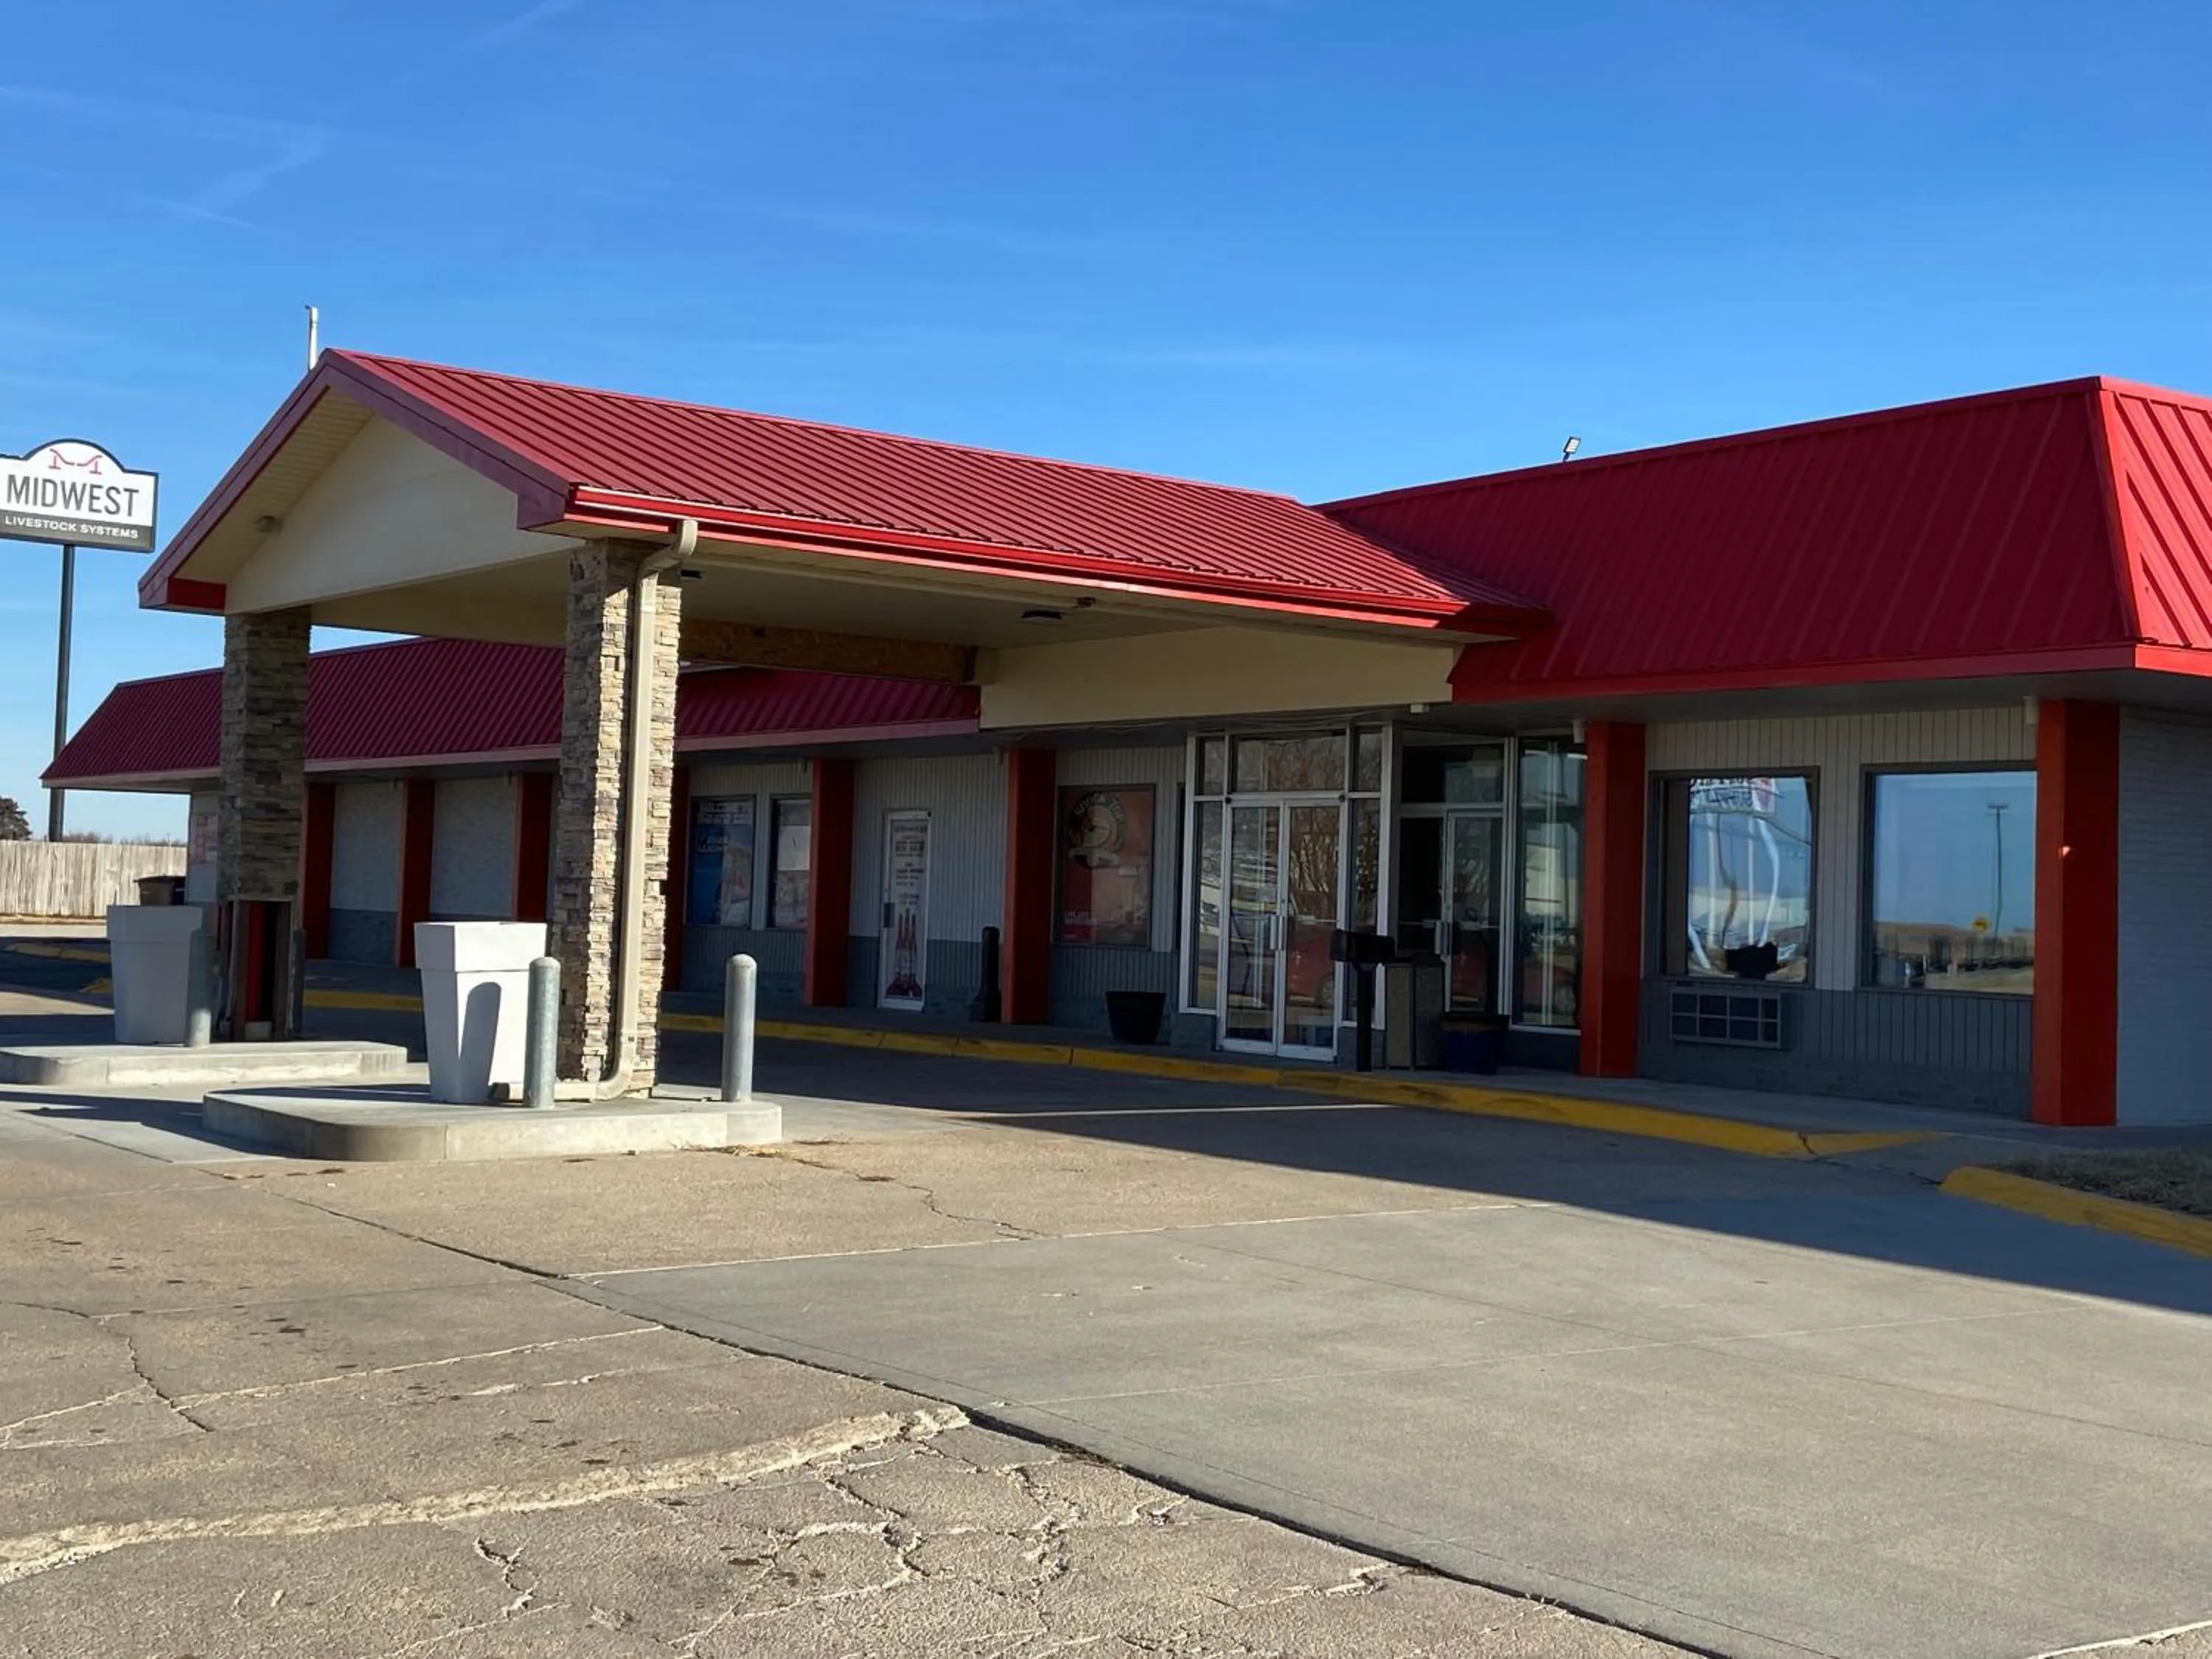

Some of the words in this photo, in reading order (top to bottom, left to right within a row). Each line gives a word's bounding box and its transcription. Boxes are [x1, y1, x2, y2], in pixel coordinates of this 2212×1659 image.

[7, 474, 139, 517] MIDWEST
[5, 515, 77, 532] LIVESTOCK
[80, 524, 139, 539] SYSTEMS
